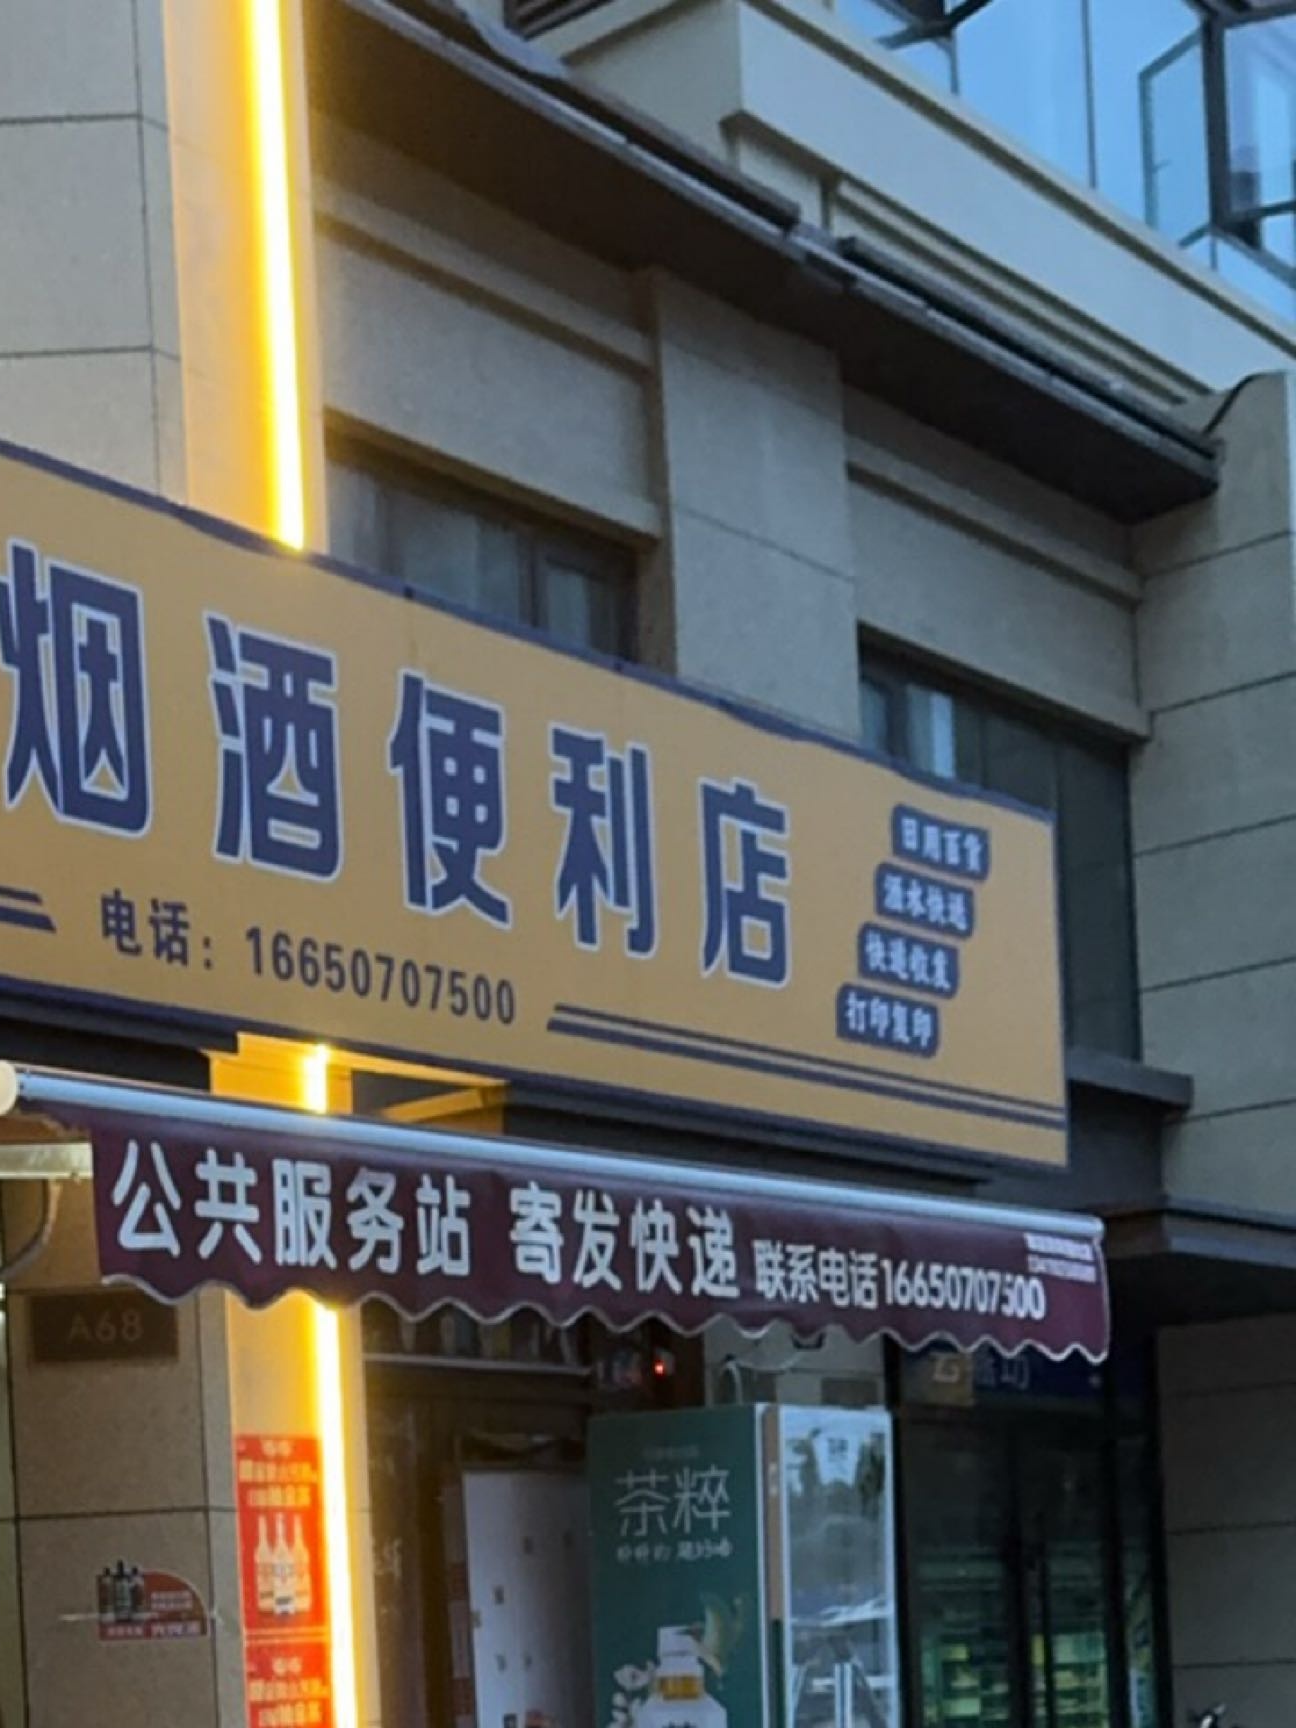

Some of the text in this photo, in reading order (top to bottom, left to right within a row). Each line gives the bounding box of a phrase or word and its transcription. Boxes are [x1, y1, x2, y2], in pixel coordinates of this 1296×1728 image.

[111, 1138, 1047, 1321] 公共服务站 寄发快递 联系电话16650707500
[65, 1307, 145, 1344] A68
[613, 1463, 732, 1537] 茶粹
